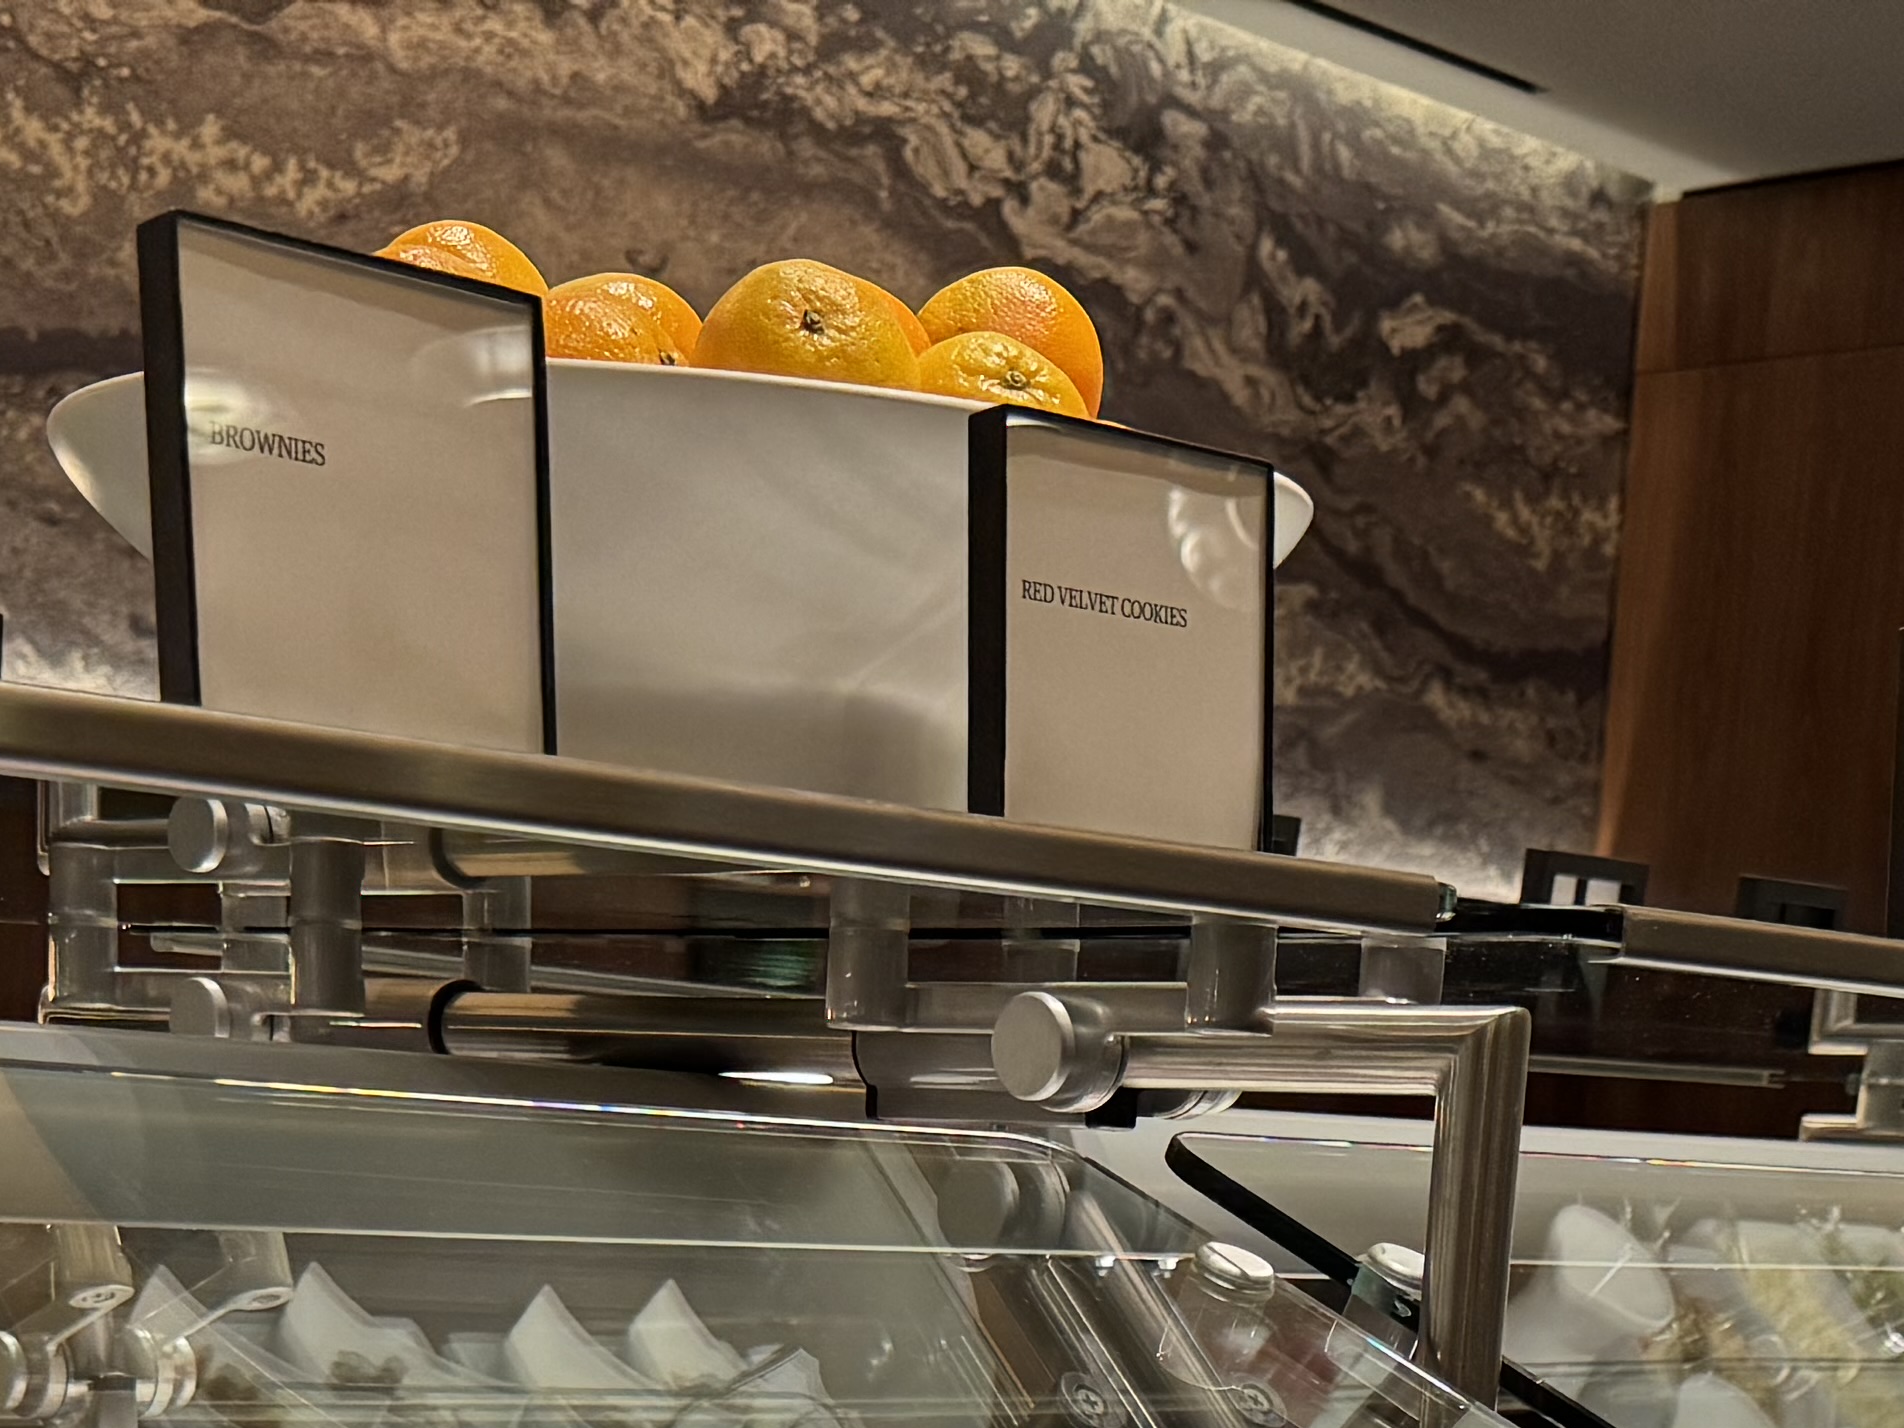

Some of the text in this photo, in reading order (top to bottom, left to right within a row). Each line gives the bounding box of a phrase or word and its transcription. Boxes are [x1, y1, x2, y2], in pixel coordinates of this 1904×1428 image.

[209, 420, 326, 467] BROWNIES
[1021, 579, 1188, 628] RED VELVET COOKIES
